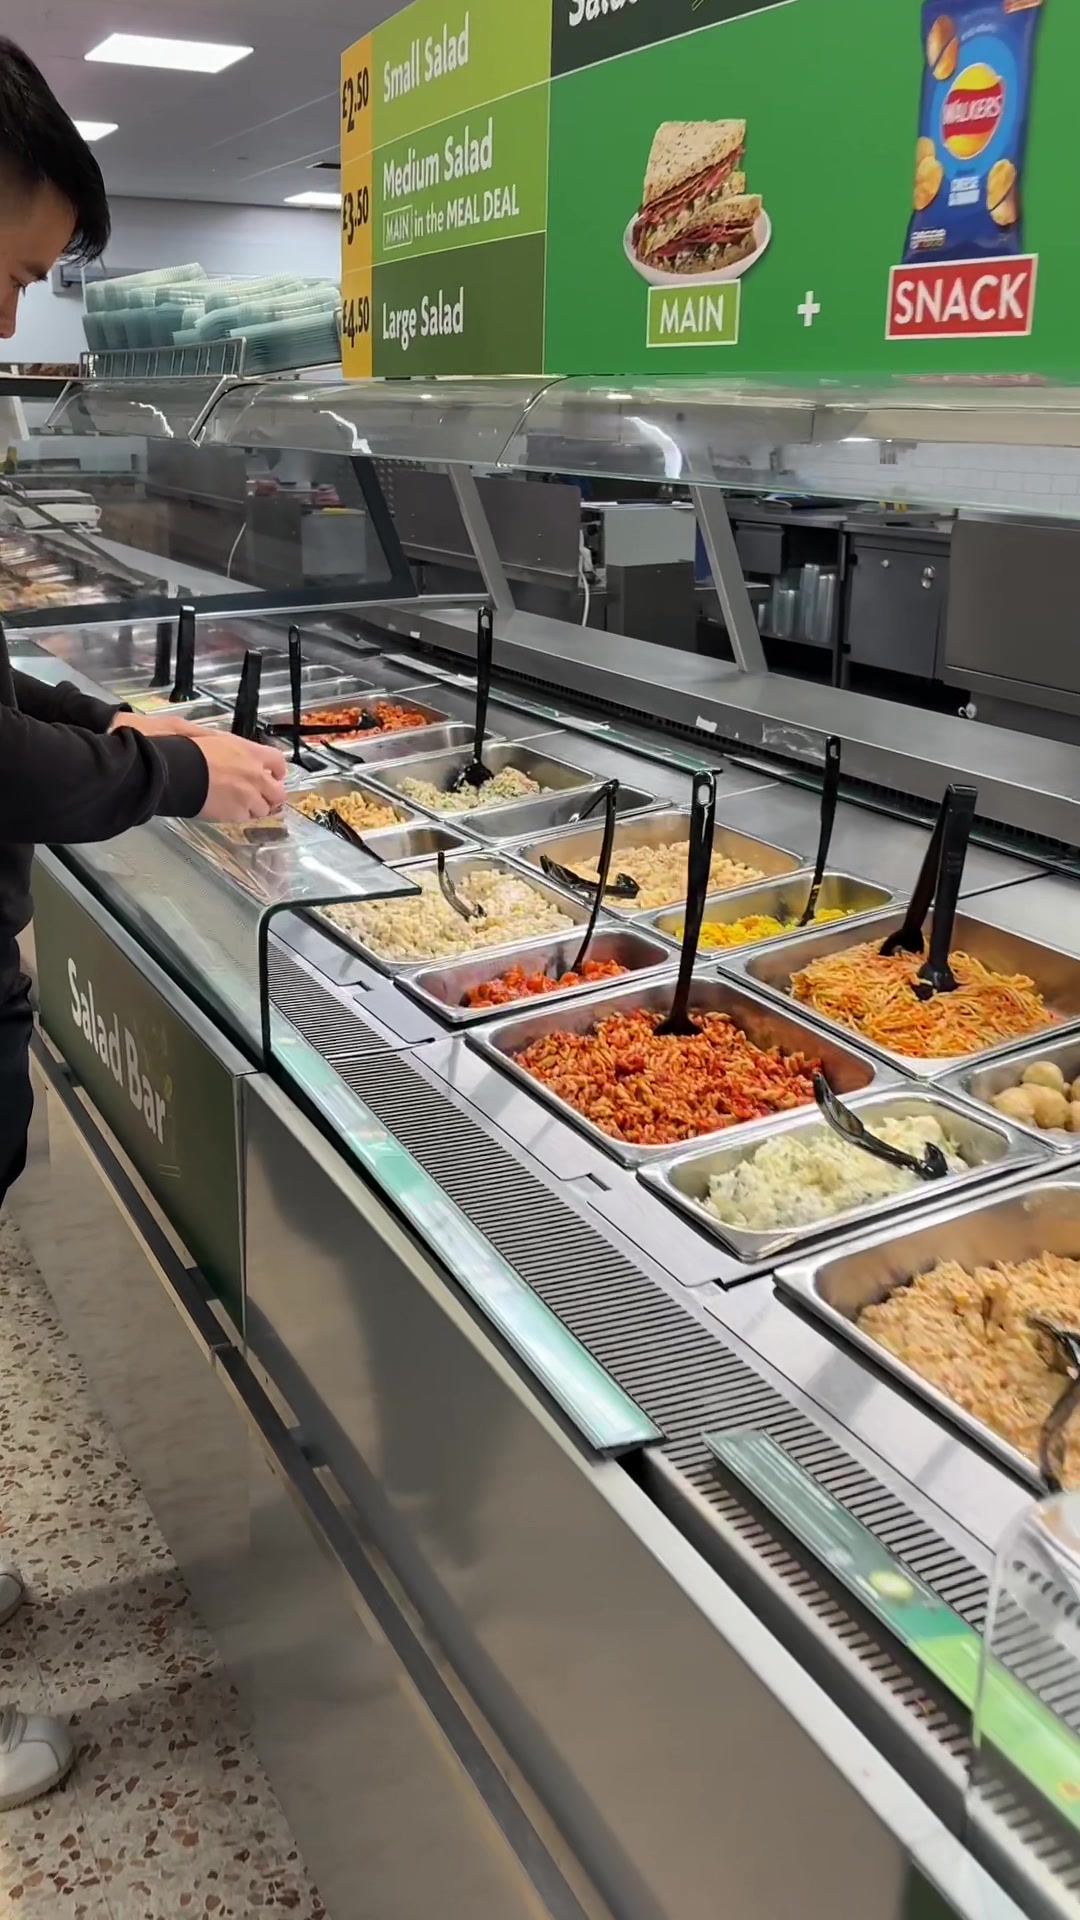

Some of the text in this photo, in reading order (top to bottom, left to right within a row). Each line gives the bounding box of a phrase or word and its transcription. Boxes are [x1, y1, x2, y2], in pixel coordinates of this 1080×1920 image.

[383, 10, 469, 103] Small Salad
[342, 66, 369, 133] £2.50
[383, 116, 493, 201] Medium Salad
[342, 185, 369, 245] £3.50
[385, 184, 520, 244] MAIN in the MEAL DEAL
[343, 295, 369, 348] £4.50
[382, 286, 464, 351] Large Salad
[659, 294, 724, 334] MAIN
[893, 272, 1028, 324] SNACK
[67, 957, 166, 1145] Salad Bar
